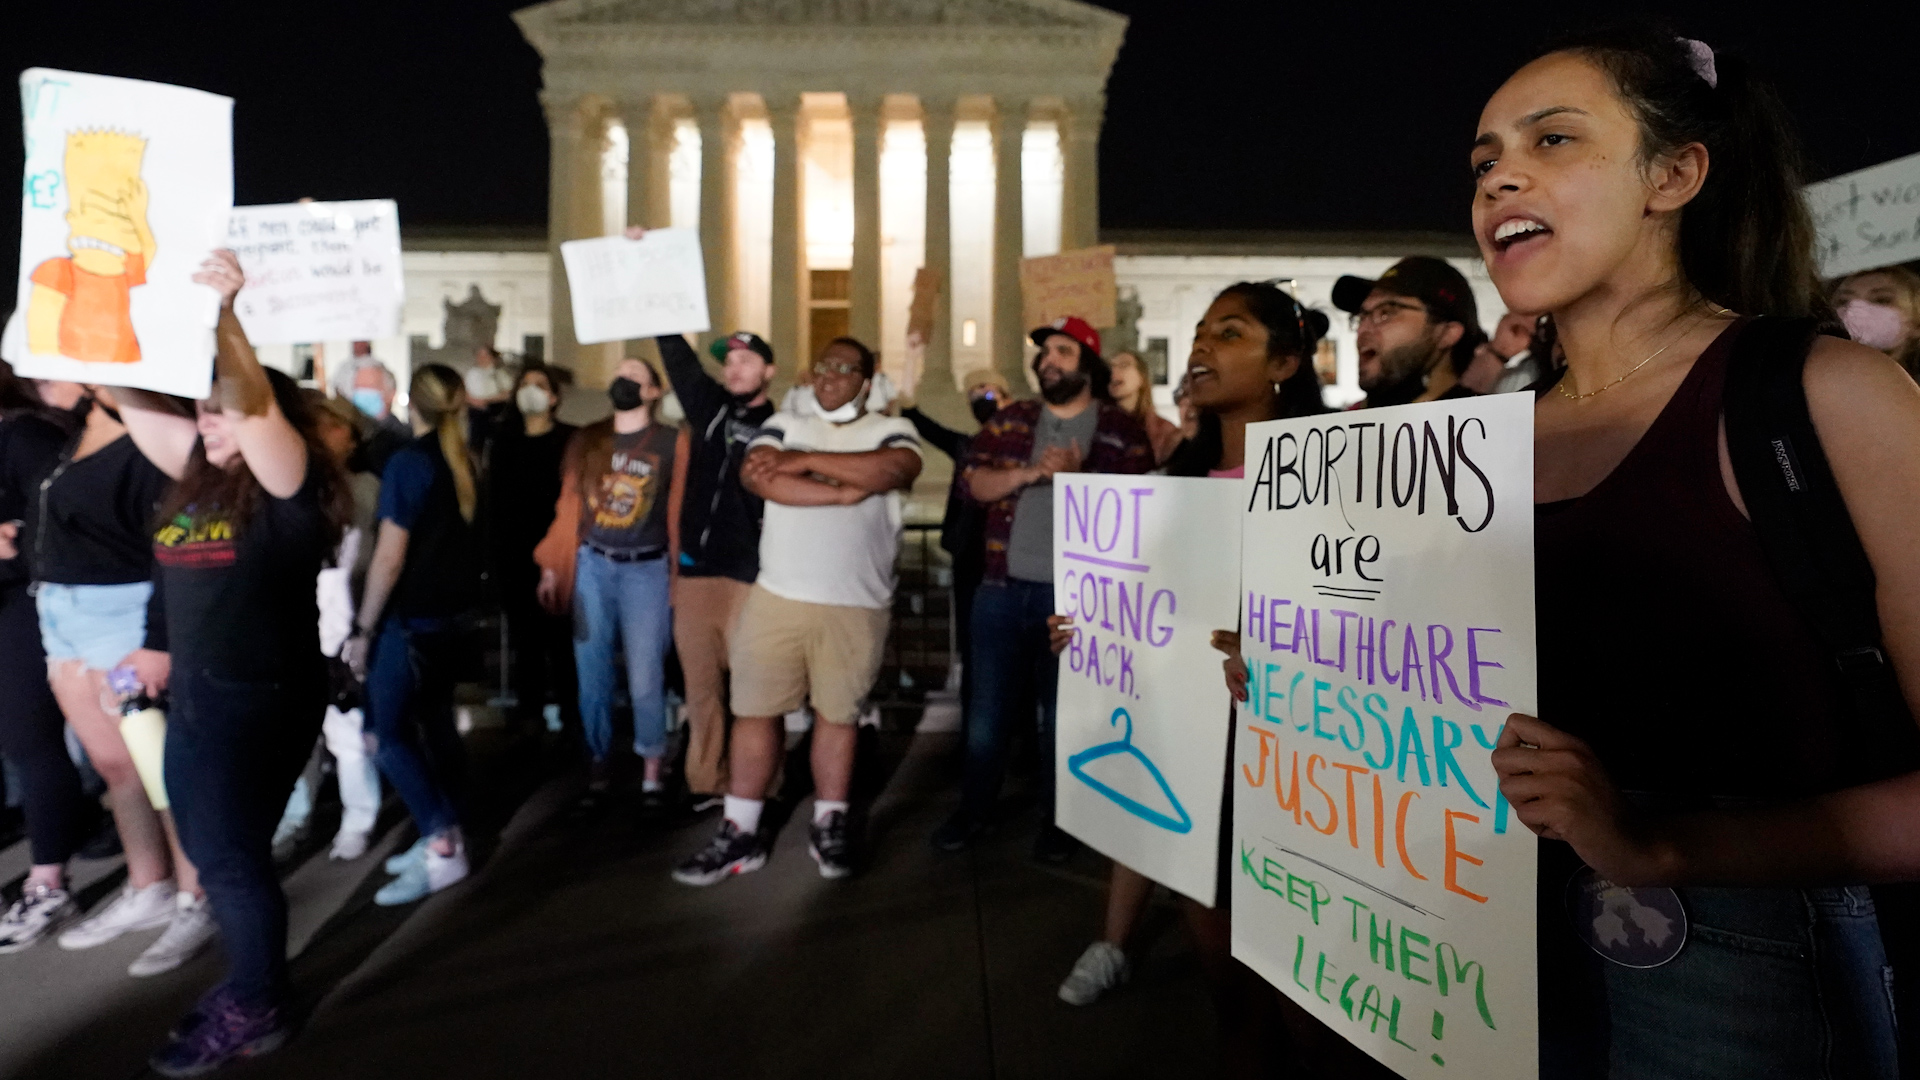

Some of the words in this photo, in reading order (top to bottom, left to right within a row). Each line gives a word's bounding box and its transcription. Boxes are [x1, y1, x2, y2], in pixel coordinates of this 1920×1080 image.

[1064, 484, 1154, 559] NOT
[1248, 415, 1495, 532] ABORTIONS
[1063, 569, 1176, 647] GOING
[1311, 534, 1384, 581] are
[1069, 627, 1141, 700] BACK.
[1249, 590, 1511, 712] HEALTHCARE
[1245, 657, 1510, 835] NECESSARY
[1243, 725, 1489, 904] JUSTICE
[1241, 838, 1331, 925] KEEP
[1343, 896, 1497, 1030] THEM
[1293, 934, 1445, 1068] LEGAL!
